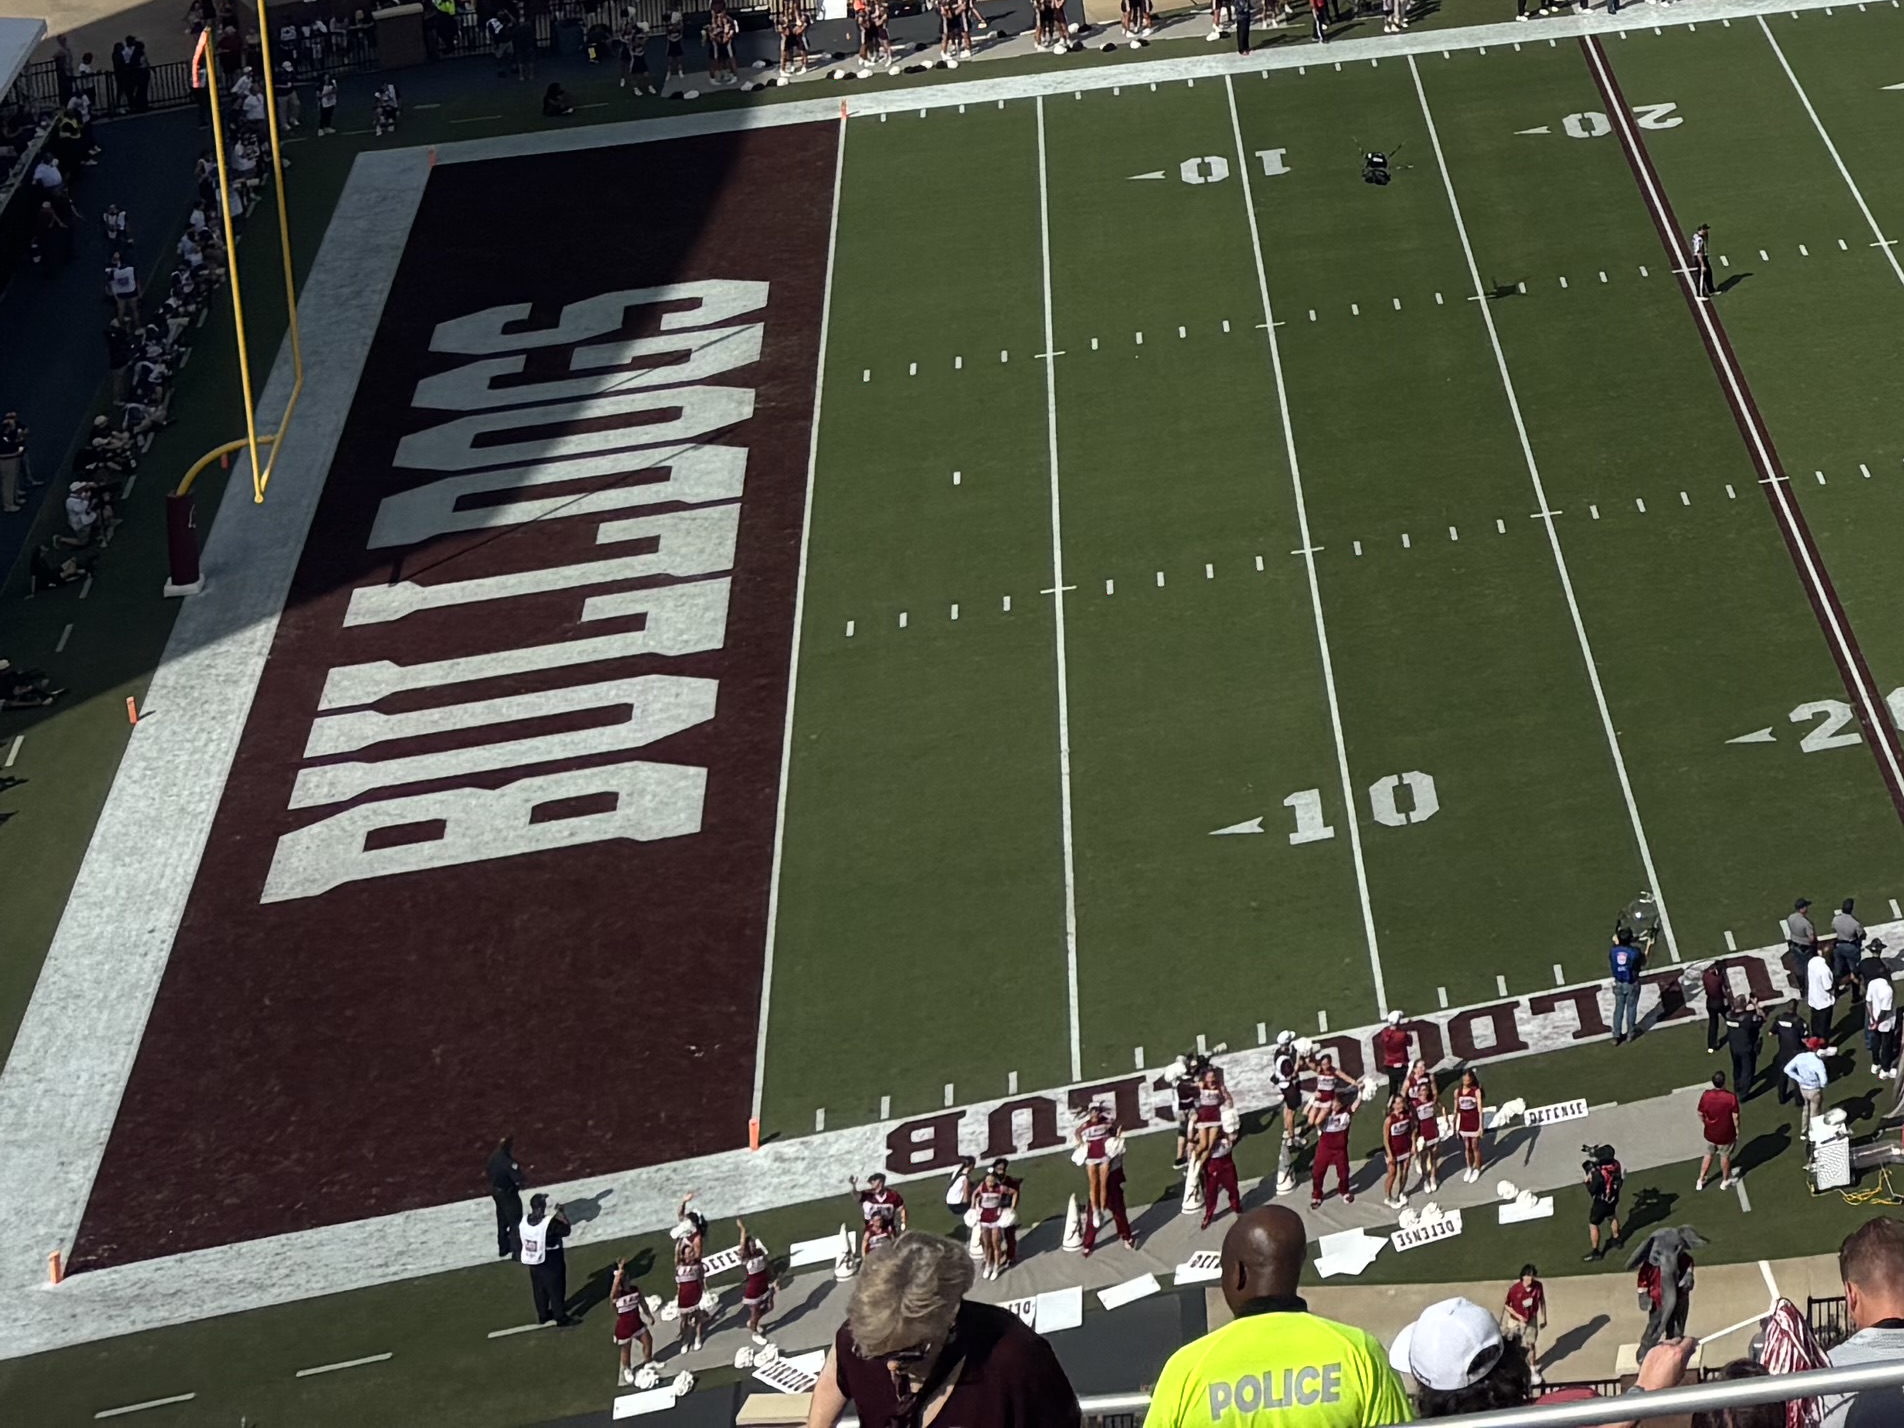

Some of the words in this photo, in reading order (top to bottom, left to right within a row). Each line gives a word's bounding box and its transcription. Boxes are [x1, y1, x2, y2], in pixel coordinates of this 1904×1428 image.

[1562, 101, 1684, 140] 20
[1180, 147, 1290, 187] 10
[259, 278, 770, 906] BULLDOGS
[1283, 770, 1438, 848] 10
[1528, 1099, 1588, 1125] DEFENSE
[1208, 1362, 1342, 1421] POLICE
